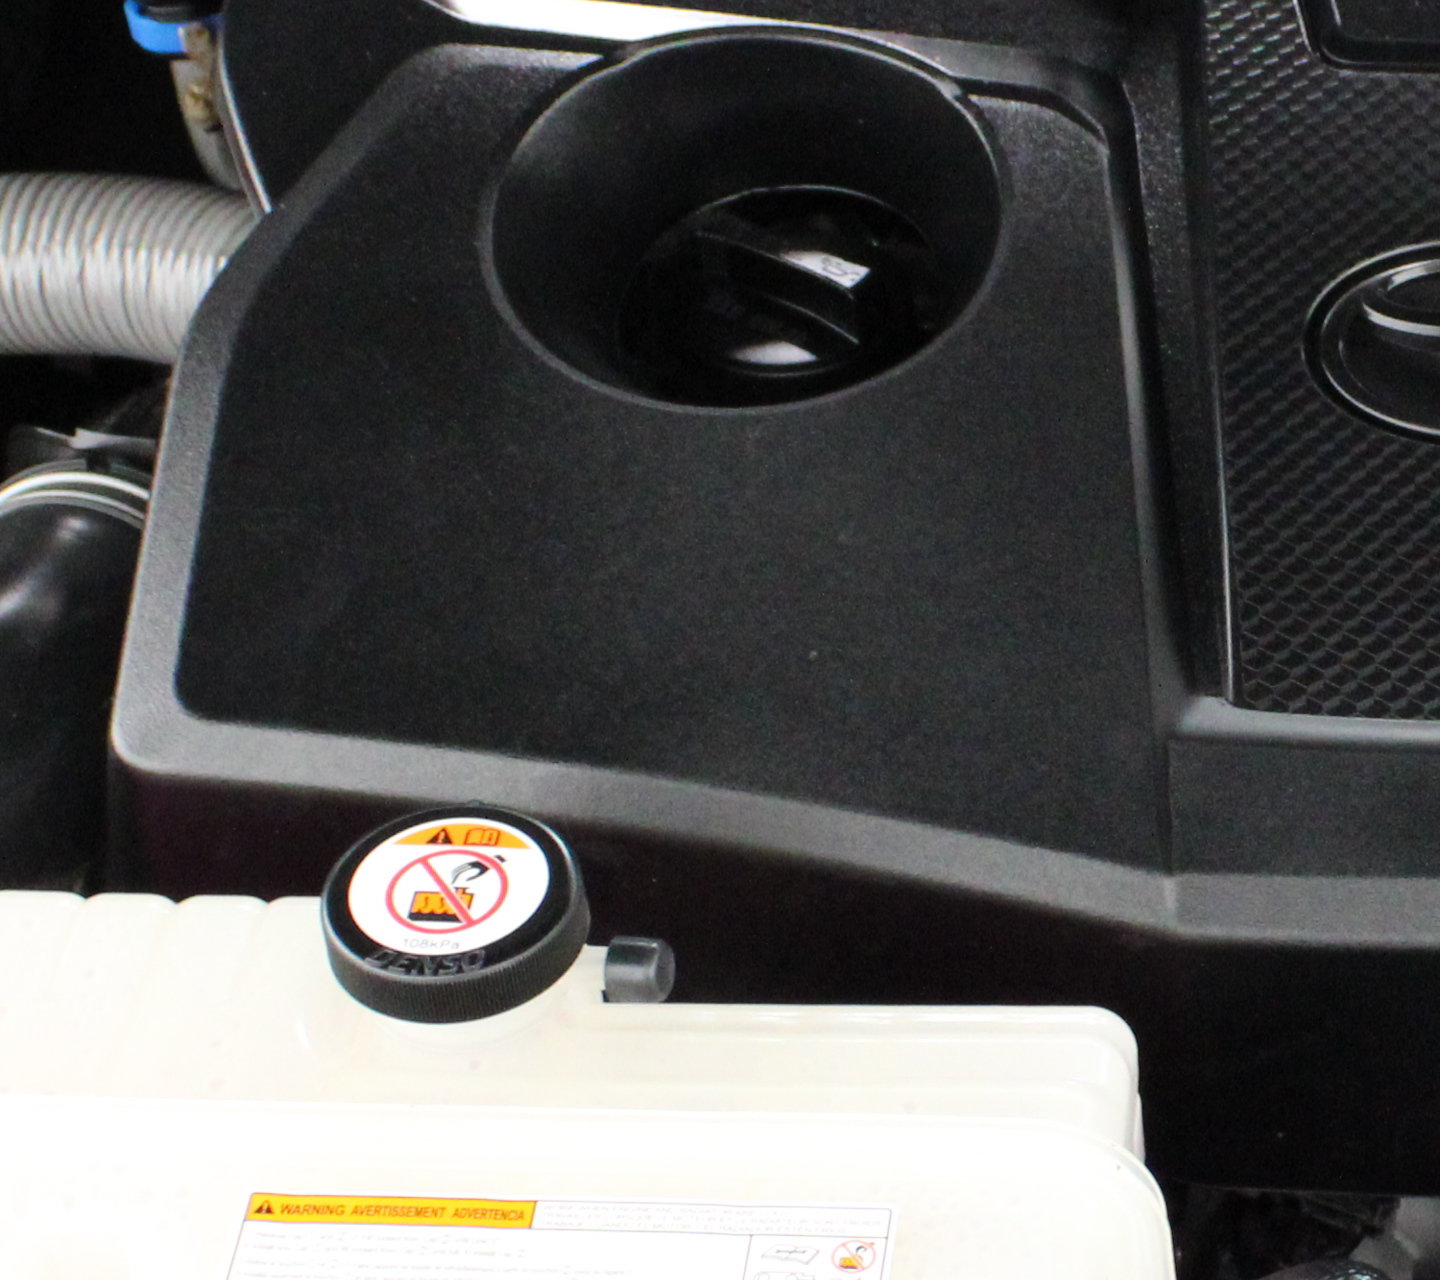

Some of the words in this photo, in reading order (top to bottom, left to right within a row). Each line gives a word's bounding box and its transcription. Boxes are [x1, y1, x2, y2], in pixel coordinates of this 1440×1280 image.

[280, 1203, 345, 1216] WARNING
[351, 1204, 446, 1219] AVERTISSEMENT
[451, 1207, 526, 1221] ADVERTENCIA
